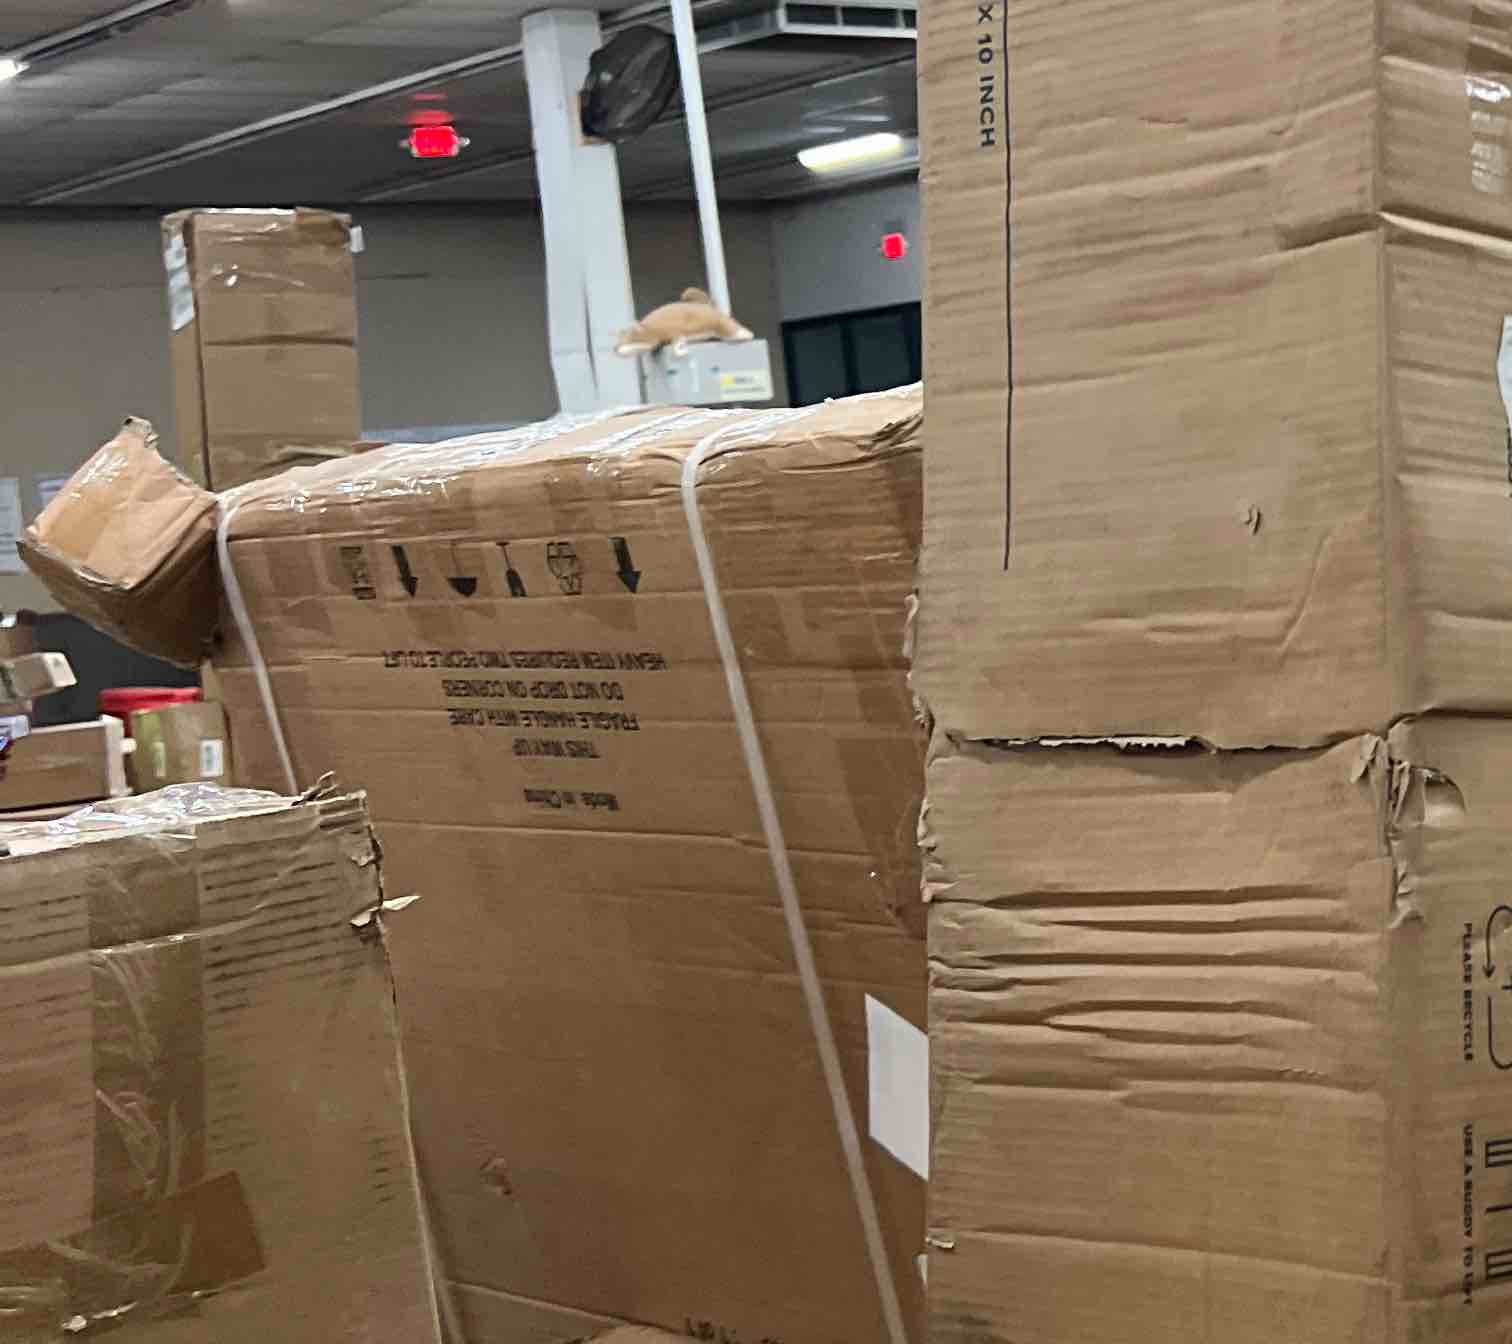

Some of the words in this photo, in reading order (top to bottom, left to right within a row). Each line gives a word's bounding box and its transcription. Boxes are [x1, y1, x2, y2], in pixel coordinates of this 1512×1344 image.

[978, 6, 993, 24] X
[977, 33, 994, 65] 10
[980, 75, 996, 148] INCH
